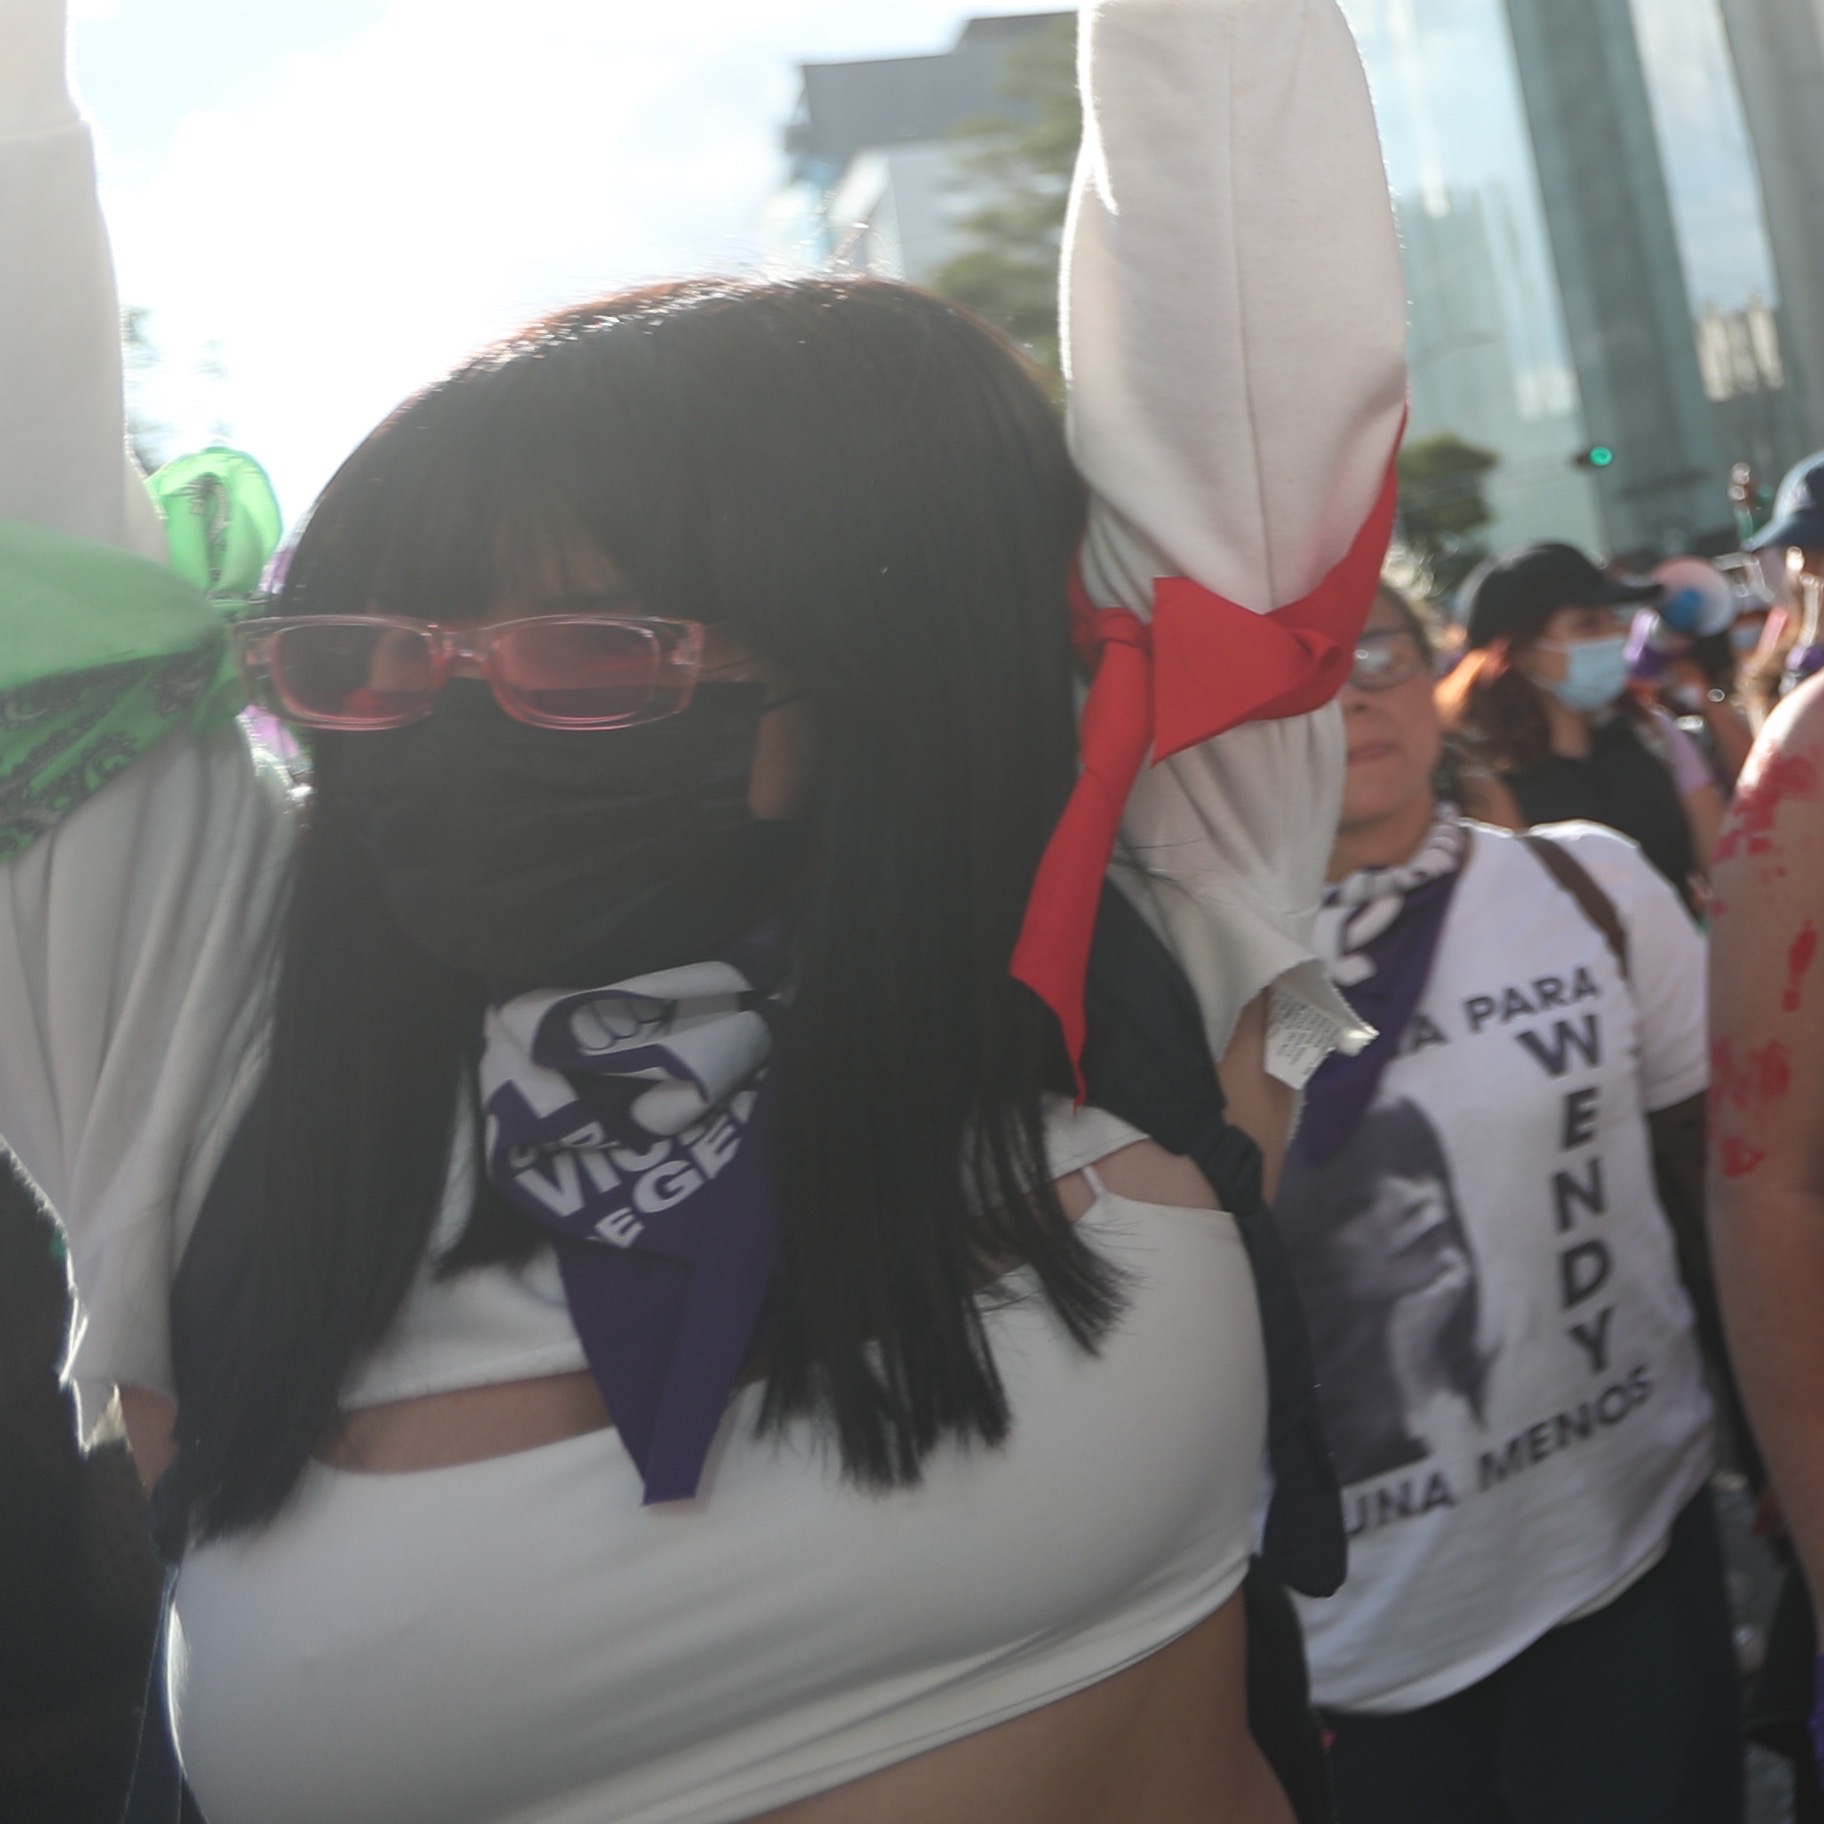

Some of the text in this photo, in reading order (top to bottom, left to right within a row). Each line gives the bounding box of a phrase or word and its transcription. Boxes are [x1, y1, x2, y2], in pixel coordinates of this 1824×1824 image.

[1464, 966, 1599, 1036] PARA
[1513, 1014, 1617, 1376] WENDY
[1476, 1364, 1655, 1492] MENOS
